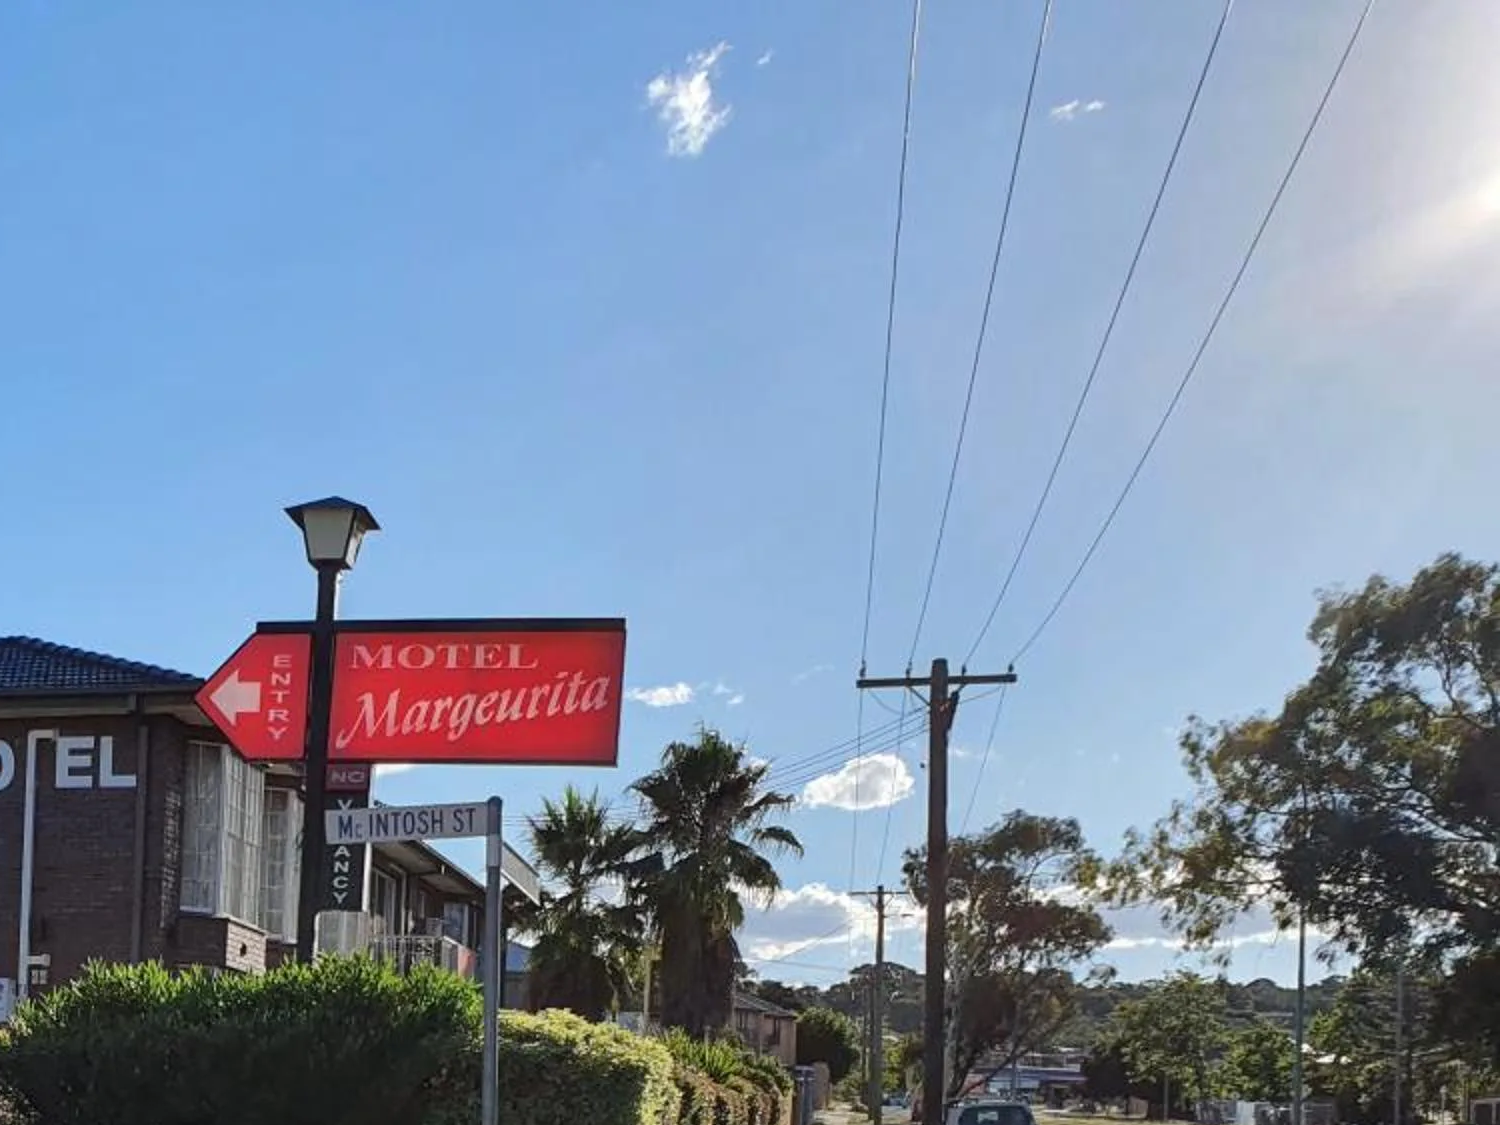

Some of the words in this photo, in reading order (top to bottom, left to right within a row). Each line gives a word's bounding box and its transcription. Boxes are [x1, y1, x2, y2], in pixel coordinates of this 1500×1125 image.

[351, 643, 539, 669] MOTEL
[267, 654, 292, 741] ENTRY
[336, 670, 610, 749] Margeurita
[331, 770, 366, 784] NO
[452, 808, 477, 833] ST
[332, 799, 353, 904] VANCY
